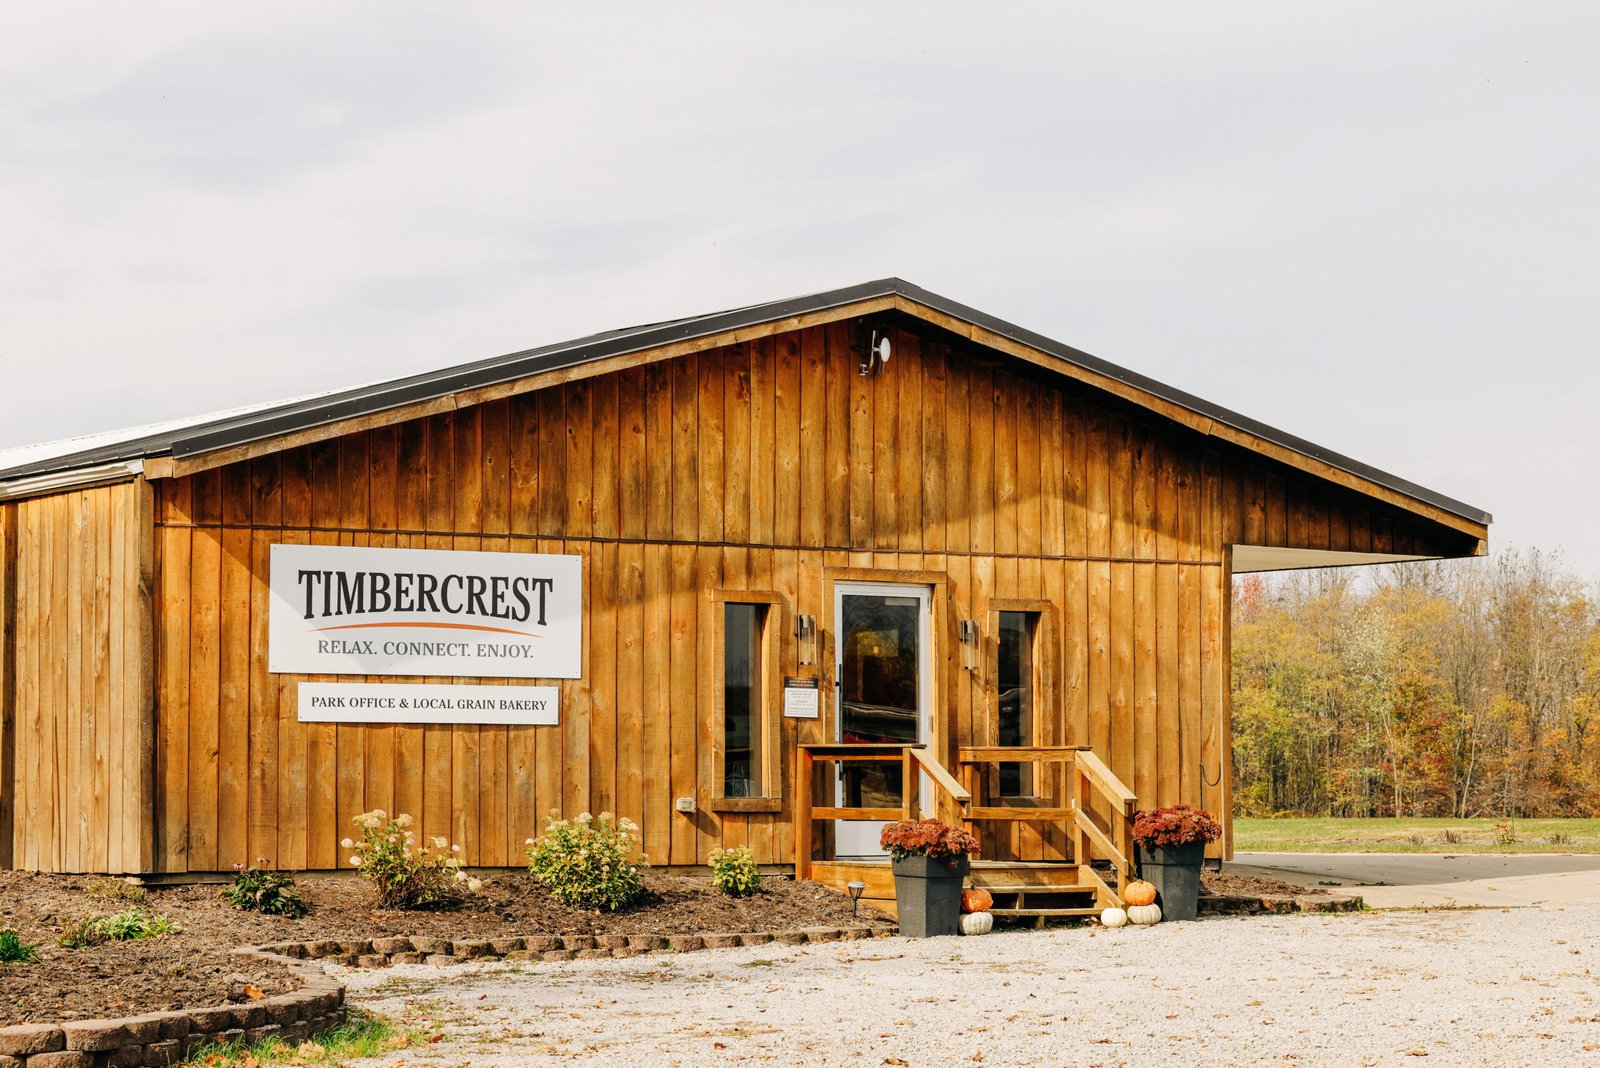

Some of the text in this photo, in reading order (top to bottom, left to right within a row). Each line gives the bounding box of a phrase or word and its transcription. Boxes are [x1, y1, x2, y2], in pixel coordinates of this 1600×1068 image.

[298, 569, 553, 626] TIMBERCREST
[319, 640, 533, 658] RELAX. CONNECT. ENJOY.
[312, 697, 547, 710] PARK OFFICE & LOCAL GRAIN BAKERY
